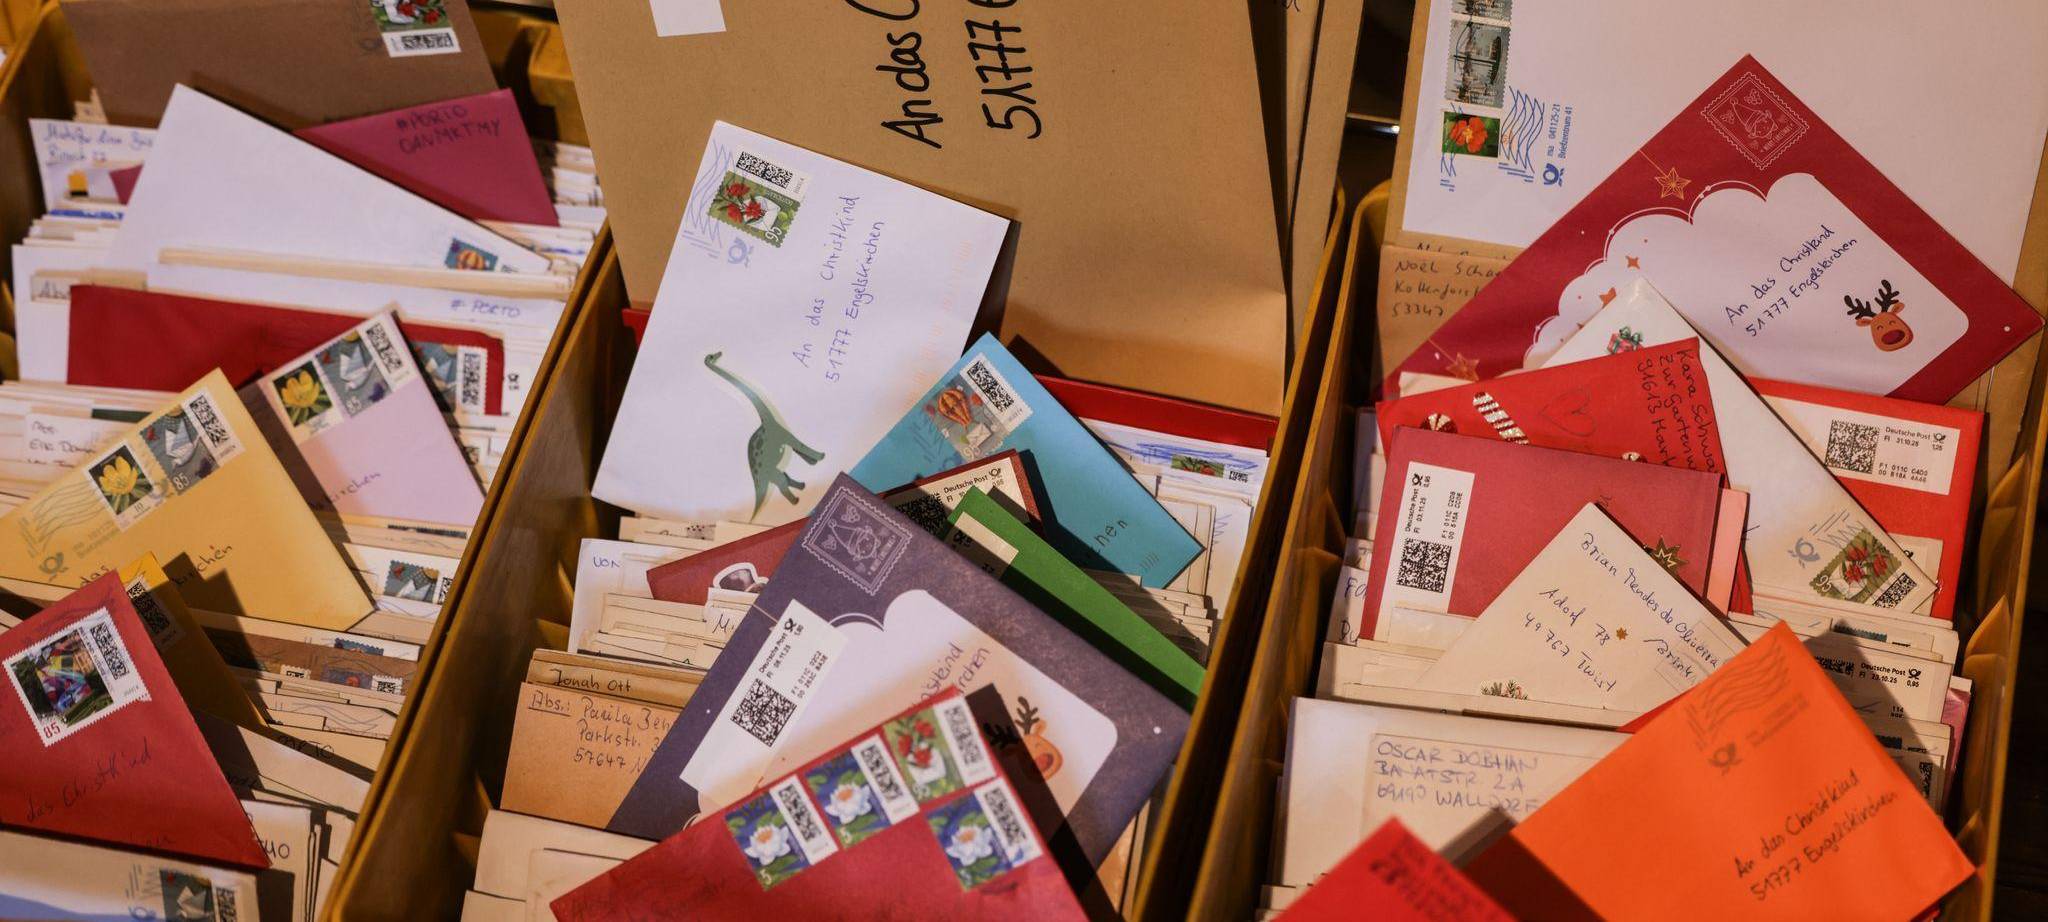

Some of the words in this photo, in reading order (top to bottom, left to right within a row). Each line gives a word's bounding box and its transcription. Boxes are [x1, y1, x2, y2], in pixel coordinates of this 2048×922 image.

[875, 31, 931, 93] das
[964, 18, 1042, 140] 51777
[880, 98, 944, 149] An
[792, 342, 813, 369] An
[809, 297, 825, 328] das
[820, 195, 861, 282] Christkind
[1722, 302, 1750, 325] An
[1753, 274, 1777, 301] das
[1779, 222, 1836, 273] Christkind
[1745, 296, 1790, 337] 51777
[1790, 238, 1858, 299] Engelskirchen
[825, 328, 853, 383] 51777
[845, 221, 885, 320] Engelskirchen
[1677, 347, 1697, 398] Kara
[1693, 404, 1716, 475] Schwa
[1884, 426, 1916, 439] Deutsche
[1915, 430, 1931, 441] Post
[943, 476, 974, 494] Deutsche
[973, 474, 989, 486] Post
[1404, 502, 1417, 532] Deutsche
[1412, 487, 1420, 503] Post
[1580, 531, 1618, 577] Brian
[758, 645, 781, 675] Deutsche
[776, 631, 790, 650] Post
[1860, 662, 1891, 674] Deutsche
[1891, 667, 1906, 676] Post
[549, 668, 601, 690] Jonah
[606, 677, 633, 693] Ott
[572, 747, 627, 768] 57647
[1376, 740, 1442, 763] OSCAR
[1733, 856, 1755, 879] An
[1760, 833, 1786, 858] das
[1784, 768, 1861, 838] Christkind
[1749, 857, 1802, 902] 51777
[1803, 788, 1899, 865] Engelskirchen
